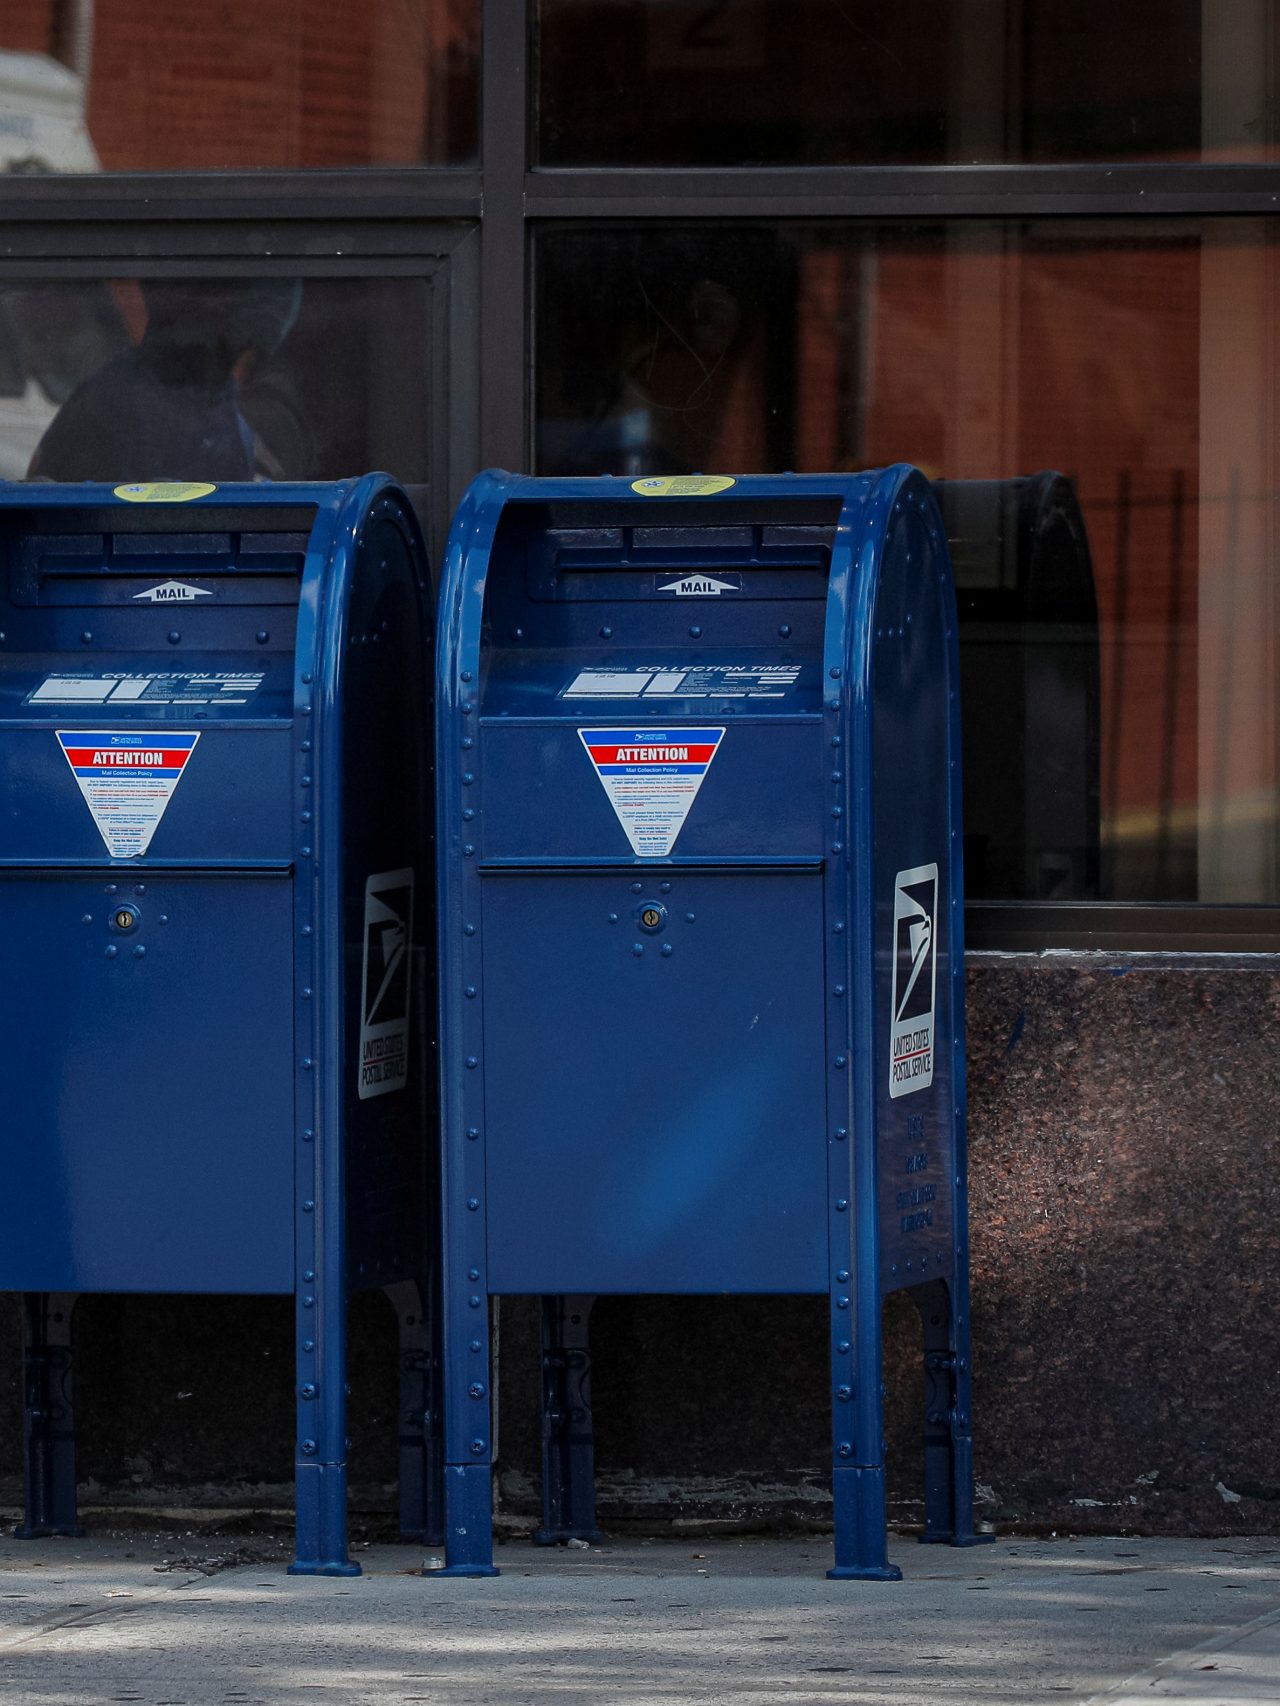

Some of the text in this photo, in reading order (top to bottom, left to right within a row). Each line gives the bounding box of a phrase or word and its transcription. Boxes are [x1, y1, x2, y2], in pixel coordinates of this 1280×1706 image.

[156, 588, 190, 599] MAIL
[681, 582, 715, 593] MAIL
[93, 752, 163, 765] ATTENTION
[616, 747, 688, 761] ATTENTION
[138, 770, 153, 778] Policy
[363, 1038, 383, 1060] UNITED
[893, 1028, 929, 1057] UNITED STATES
[893, 1054, 931, 1083] POSTAL SERVICE
